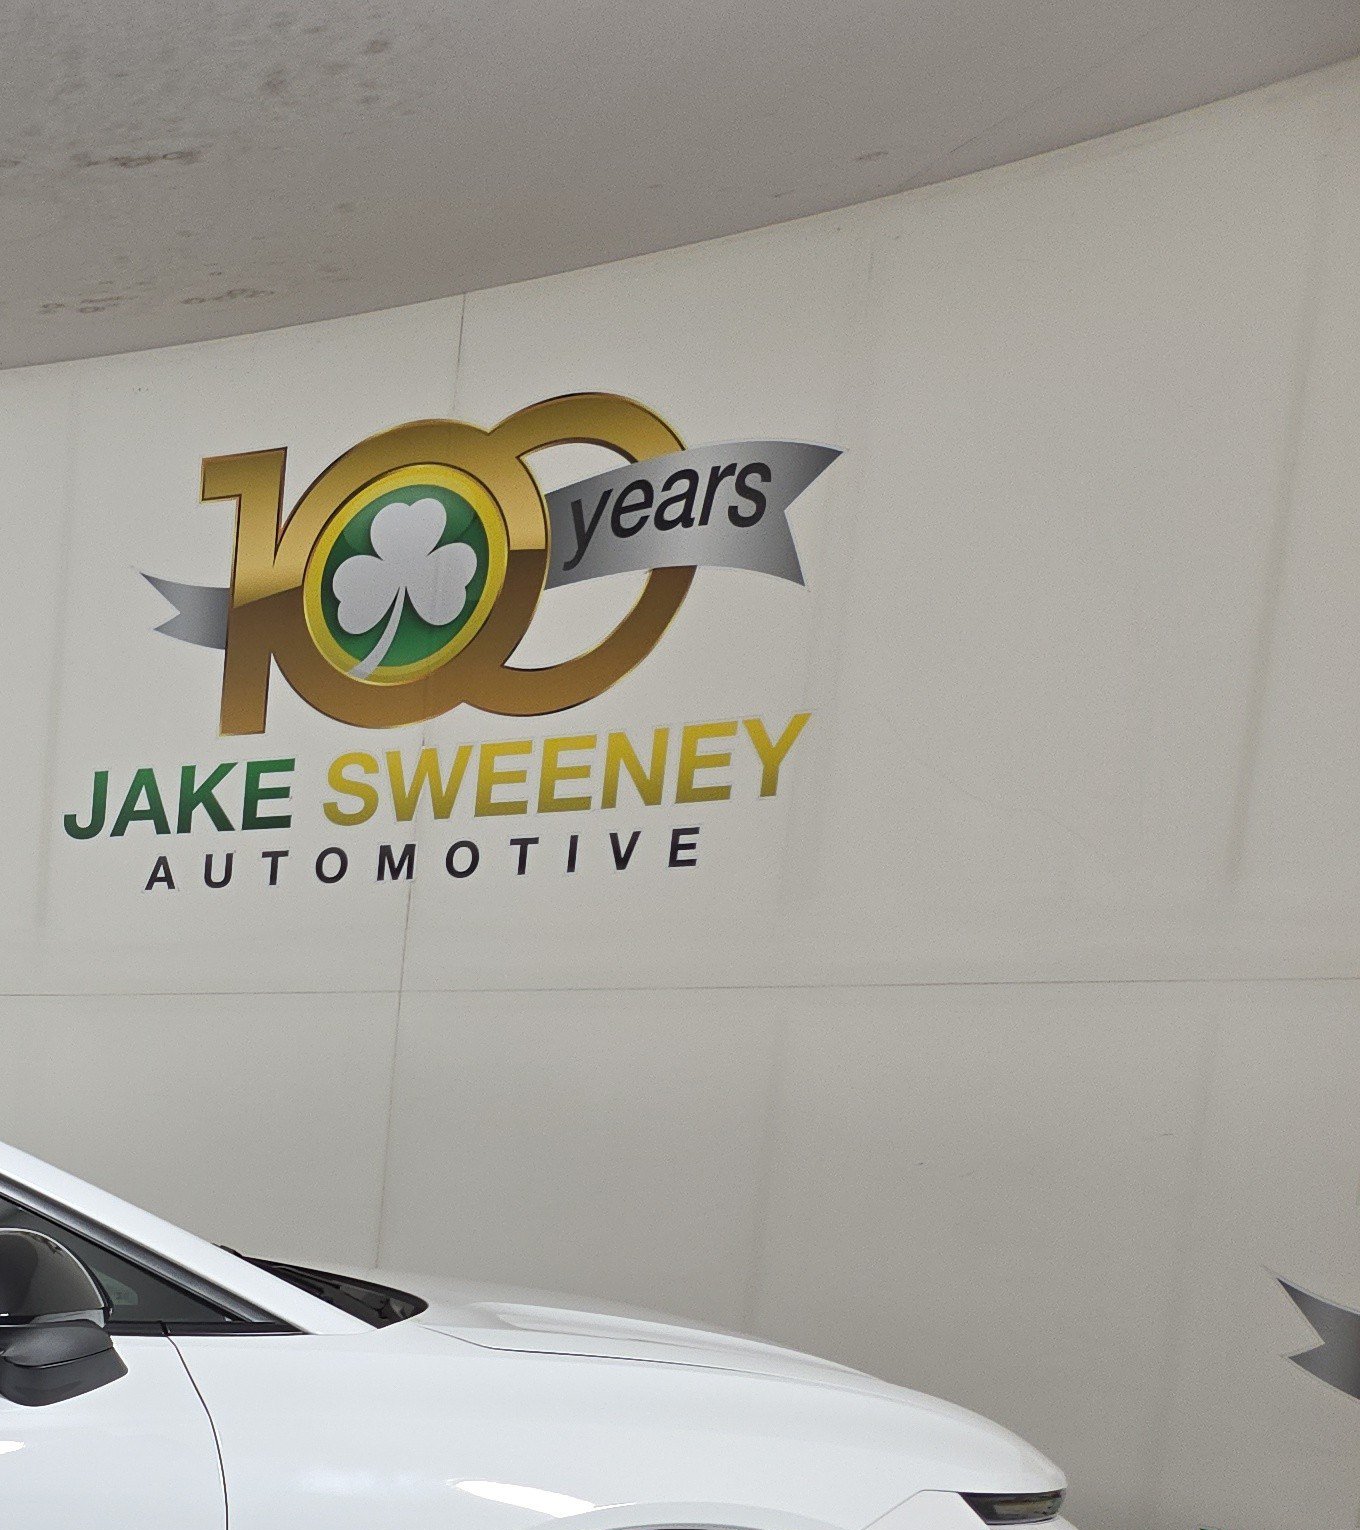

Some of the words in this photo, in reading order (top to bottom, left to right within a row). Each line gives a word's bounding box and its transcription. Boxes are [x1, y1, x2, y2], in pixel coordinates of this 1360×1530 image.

[563, 458, 772, 572] years
[63, 758, 296, 840] JAKE
[322, 713, 813, 827] SWEENEY
[144, 826, 701, 892] AUTOMOTIVE
